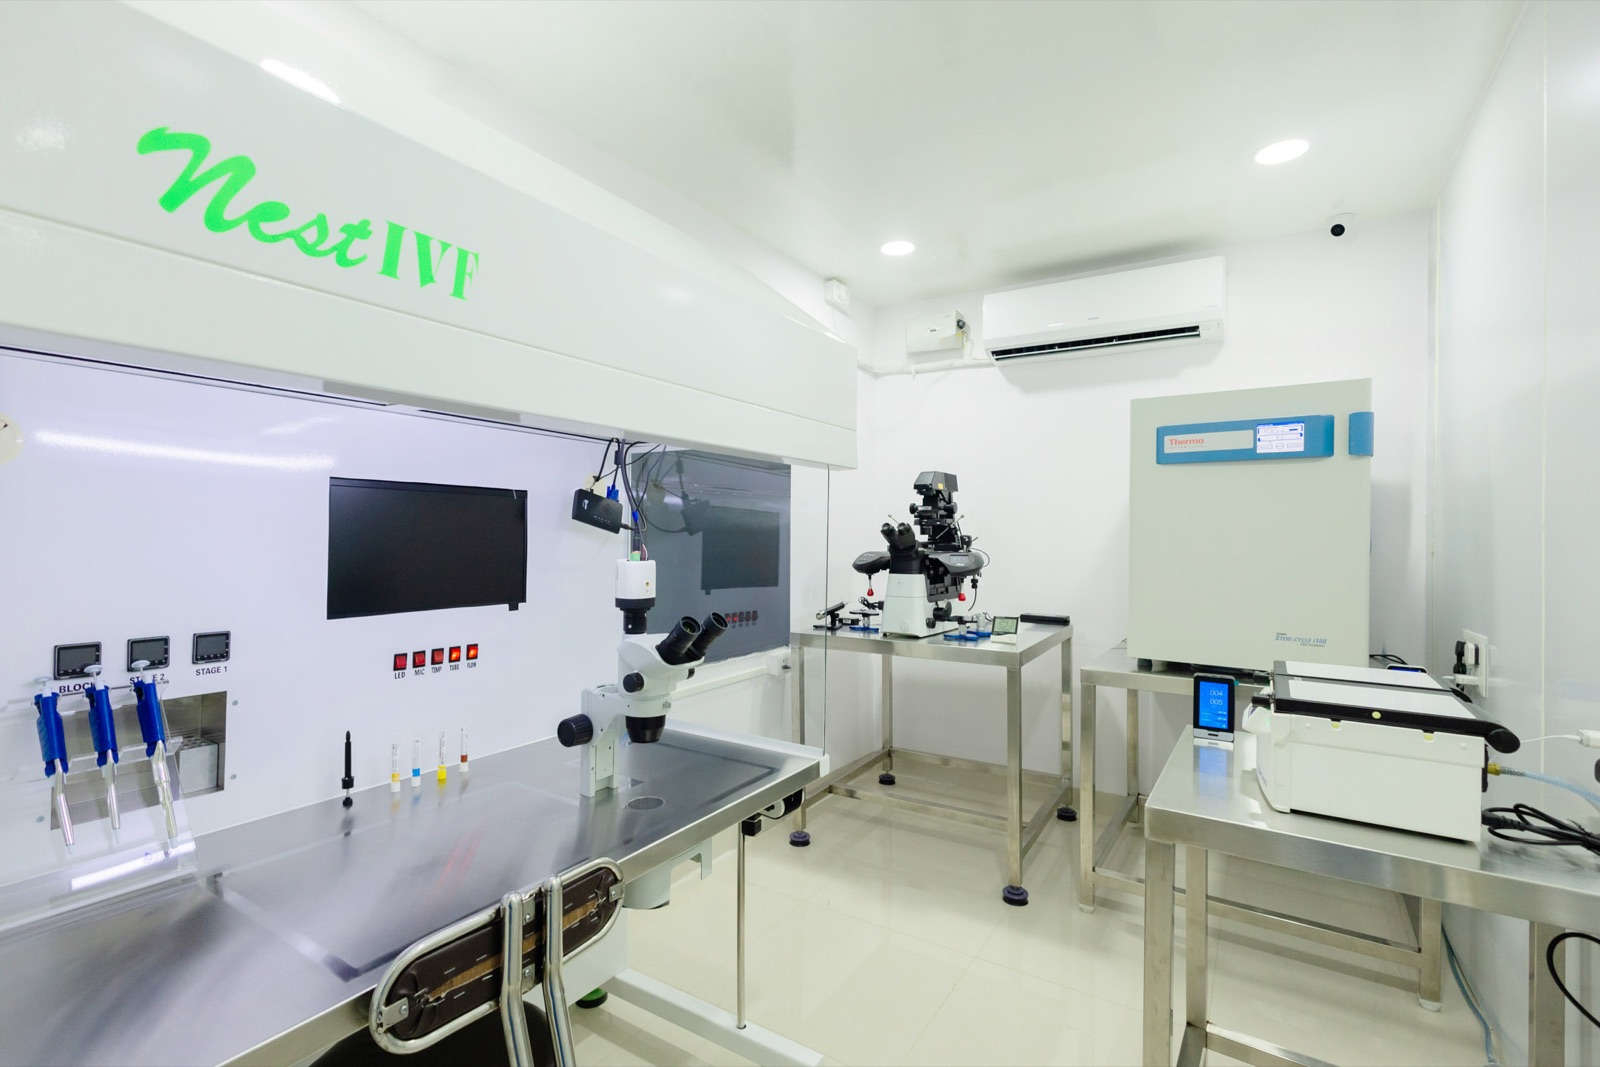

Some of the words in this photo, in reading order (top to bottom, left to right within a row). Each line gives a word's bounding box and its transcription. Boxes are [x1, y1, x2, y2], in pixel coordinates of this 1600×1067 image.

[379, 222, 479, 300] IVF
[1168, 437, 1205, 446] Thermo
[431, 665, 442, 673] TEMP
[449, 663, 460, 671] TUBE
[466, 661, 477, 669] FLOW
[195, 668, 222, 676] STAGE
[394, 671, 406, 679] LED
[414, 668, 426, 676] MIC
[129, 674, 158, 684] STE
[160, 673, 165, 681] 2
[1209, 689, 1223, 697] 004
[1209, 698, 1223, 706] 005
